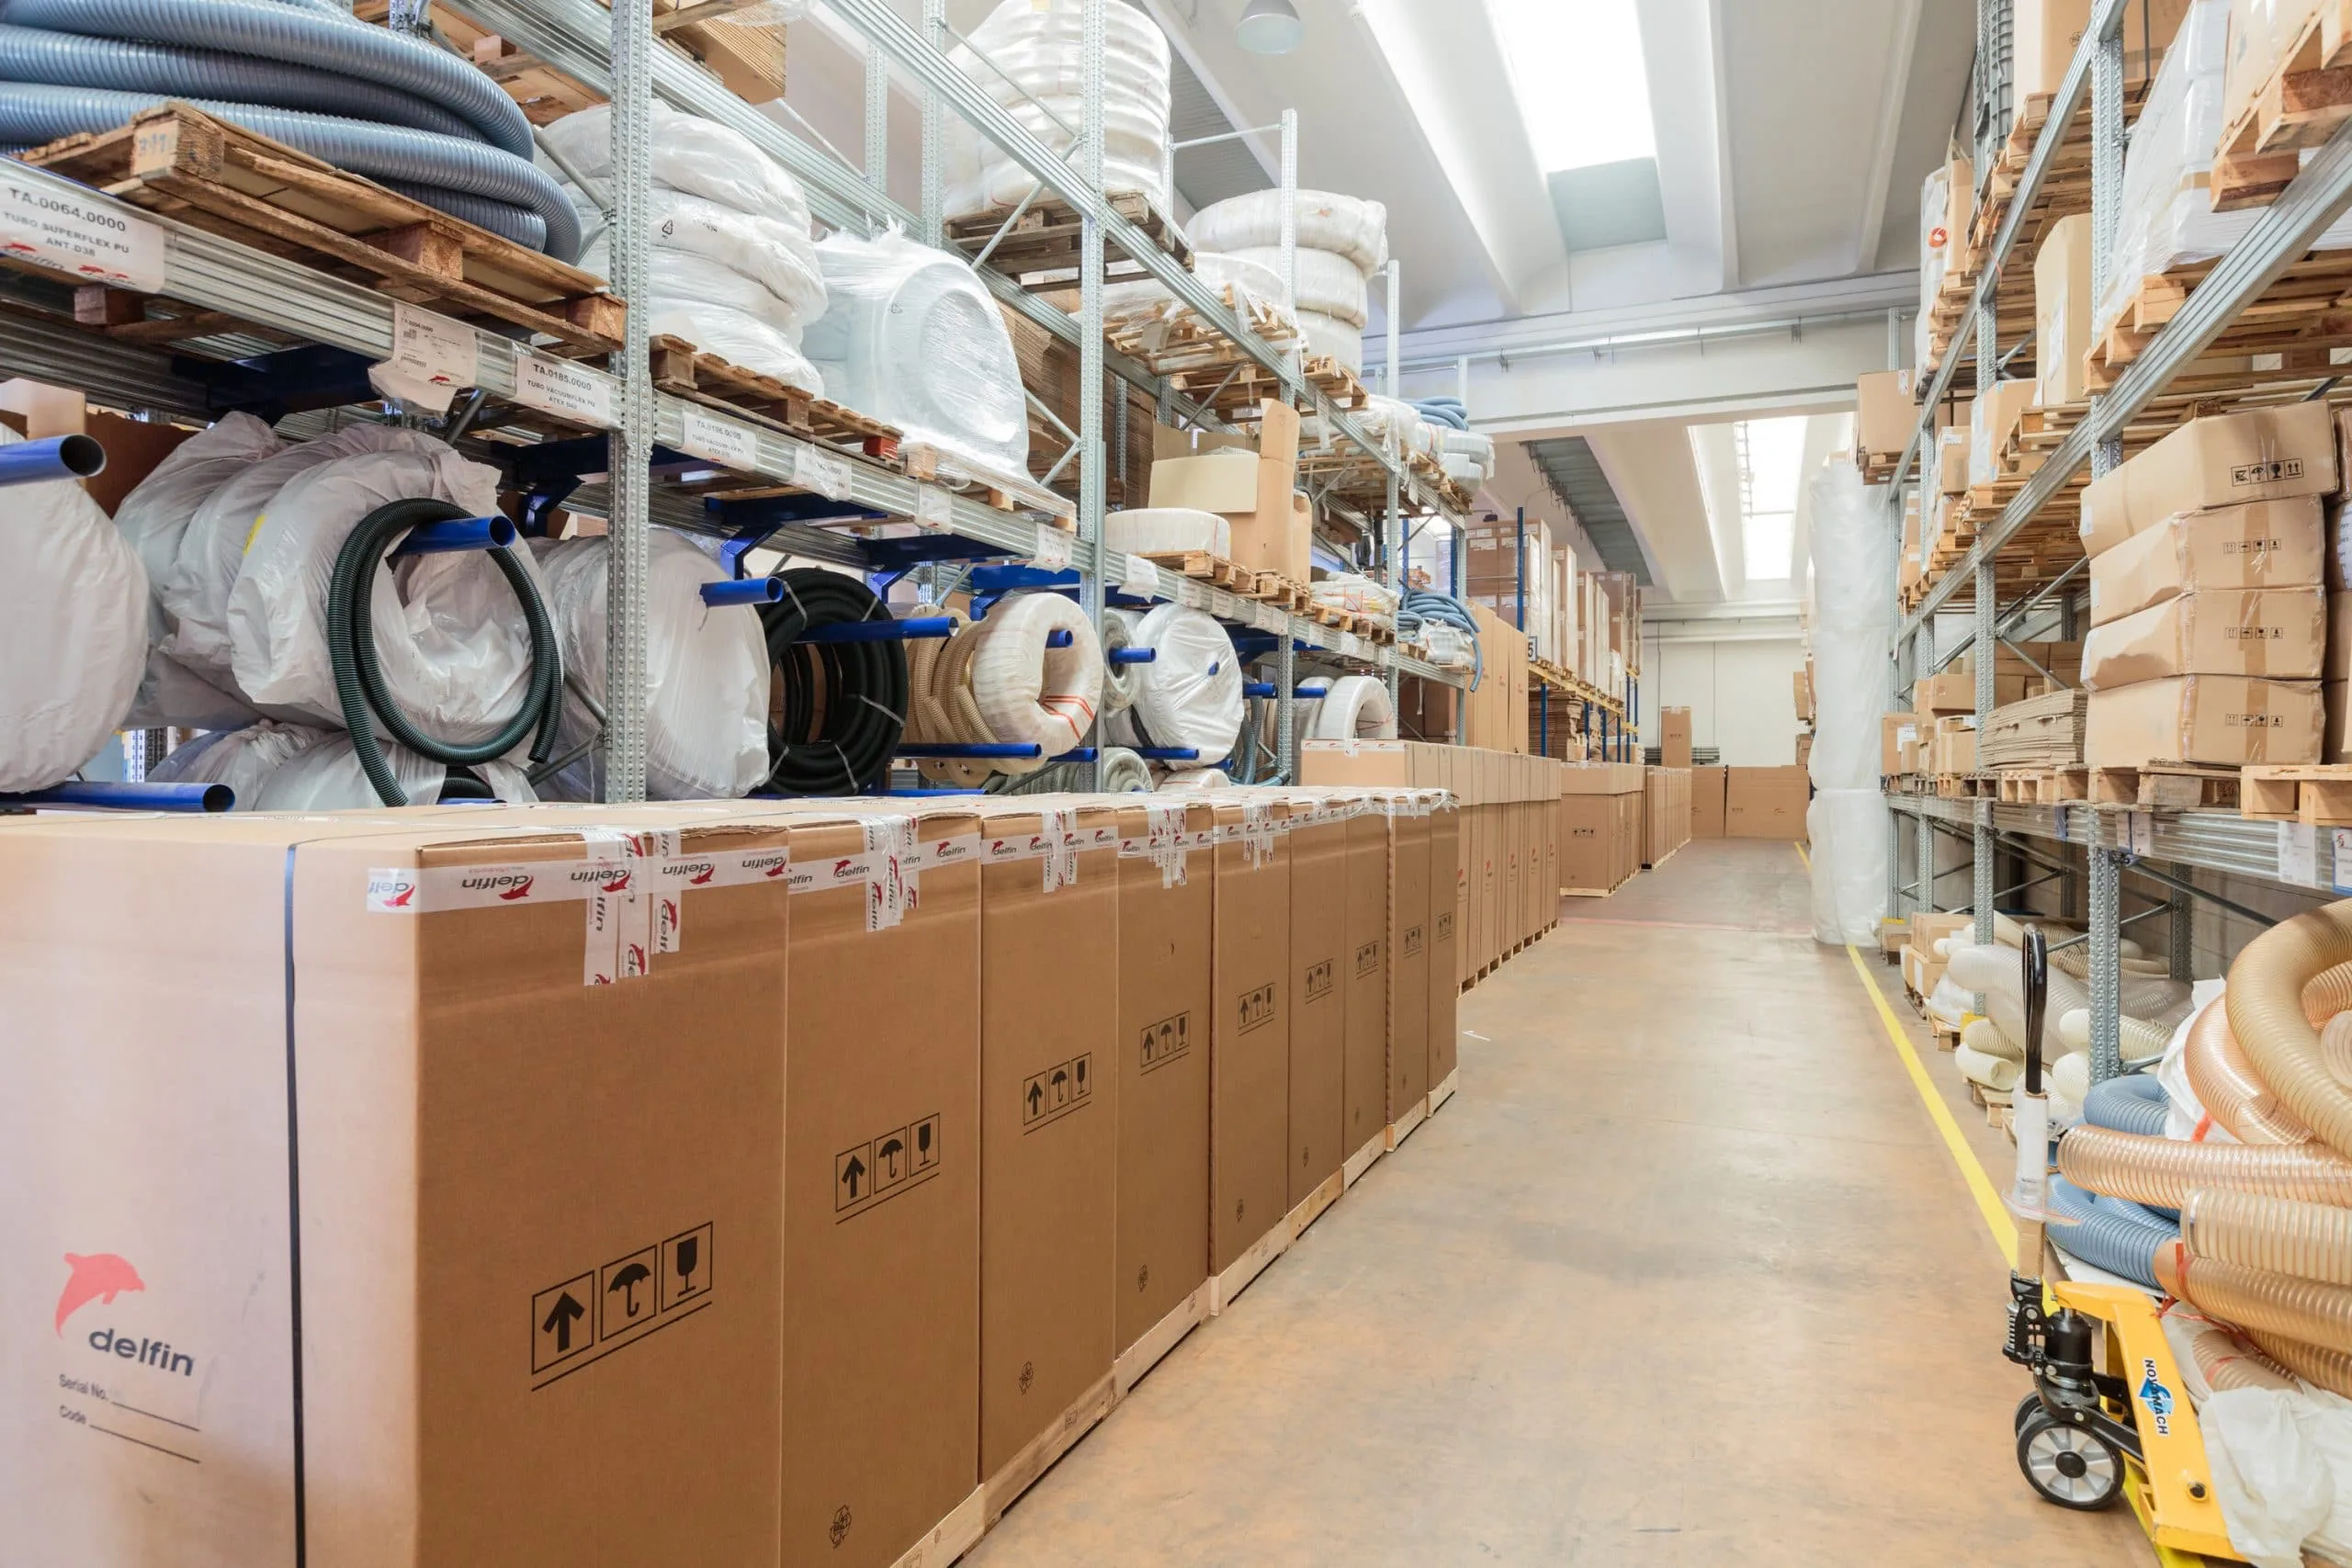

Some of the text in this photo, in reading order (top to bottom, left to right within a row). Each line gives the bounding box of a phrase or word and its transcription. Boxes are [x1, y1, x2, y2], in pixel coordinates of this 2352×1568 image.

[8, 187, 126, 232] TA.0064.0000
[3, 211, 130, 254] TUBO SUPERFLEX PU
[533, 364, 592, 391] TA.0185.0000
[1066, 838, 1085, 847] delfin
[938, 846, 967, 858] delfin
[993, 846, 1017, 856] delfin
[662, 862, 712, 876] delfin
[741, 855, 785, 869] delfin
[571, 868, 628, 884] delfin
[836, 865, 870, 878] delfin
[461, 874, 529, 890] delfin
[88, 1328, 196, 1377] delfin
[59, 1374, 108, 1401] Serial No.
[2144, 1359, 2169, 1435] NOVAMACH
[59, 1404, 87, 1426] Code
